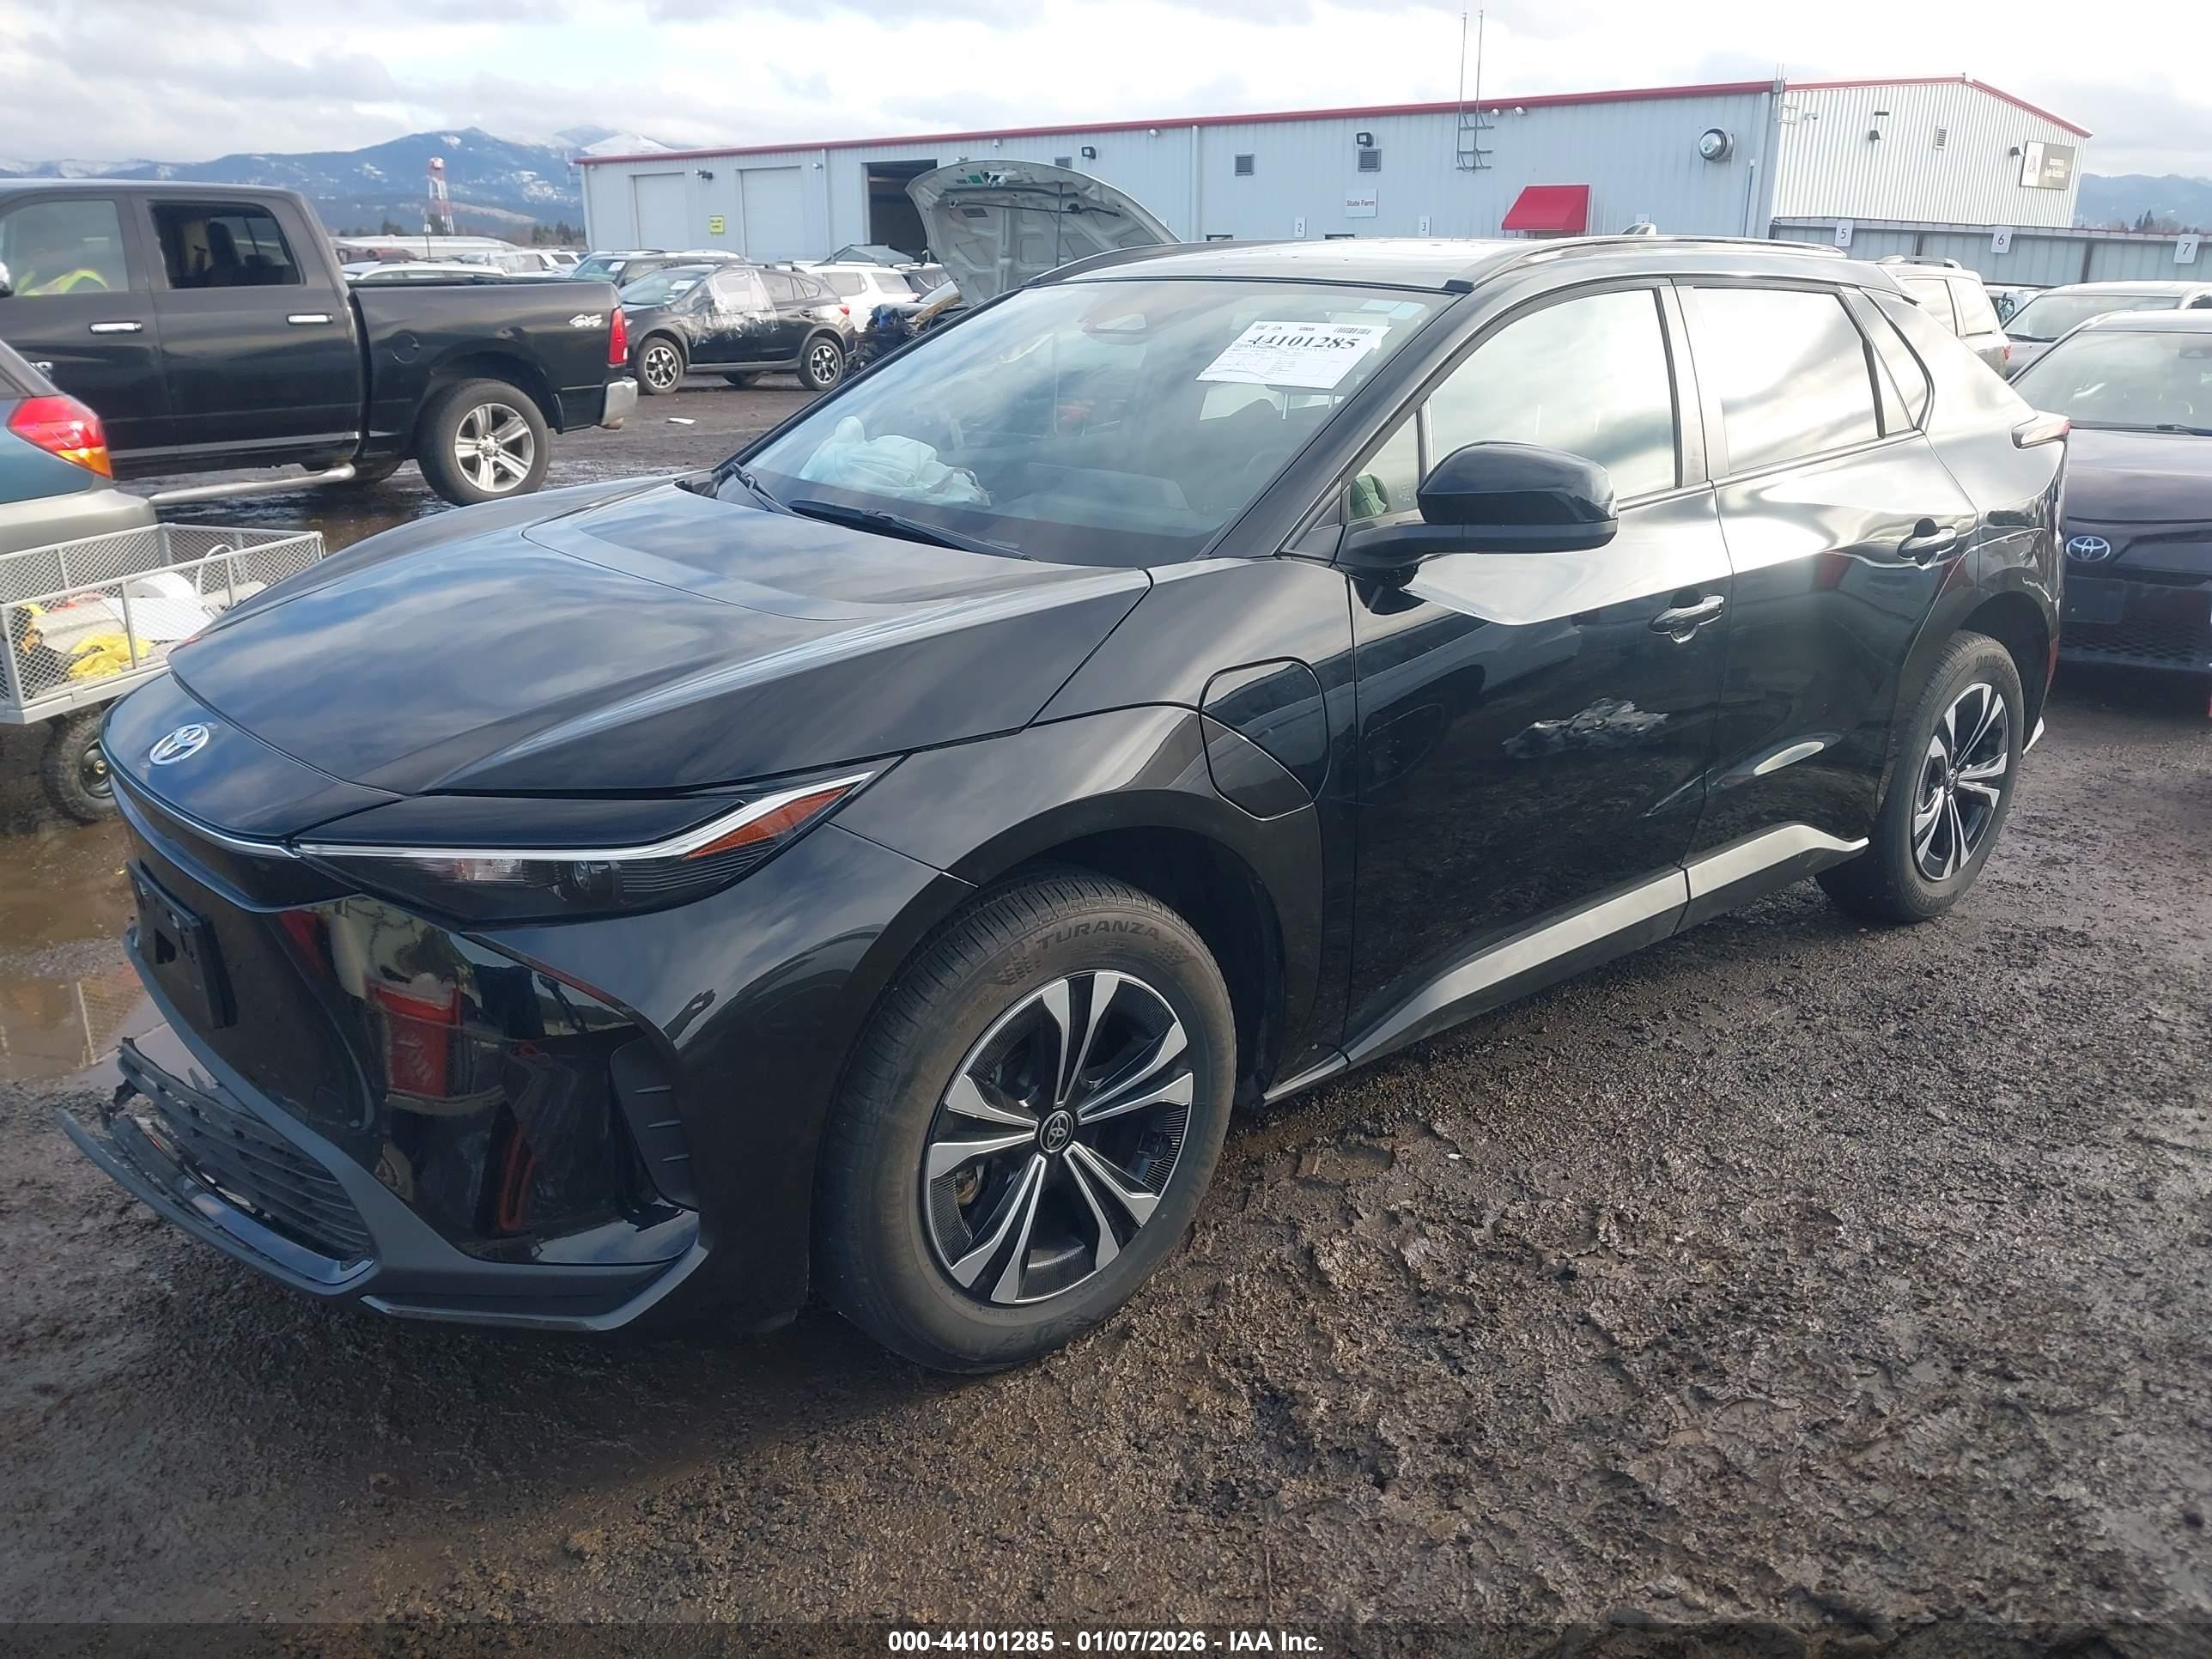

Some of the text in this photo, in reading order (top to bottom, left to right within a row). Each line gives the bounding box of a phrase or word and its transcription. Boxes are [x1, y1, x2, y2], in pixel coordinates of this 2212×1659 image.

[1297, 222, 1303, 233] 2
[1421, 222, 1427, 232] 3
[1840, 228, 1847, 240] 5
[1997, 234, 2005, 246] 6
[2183, 242, 2192, 255] 7
[1036, 920, 1160, 951] TURANZA
